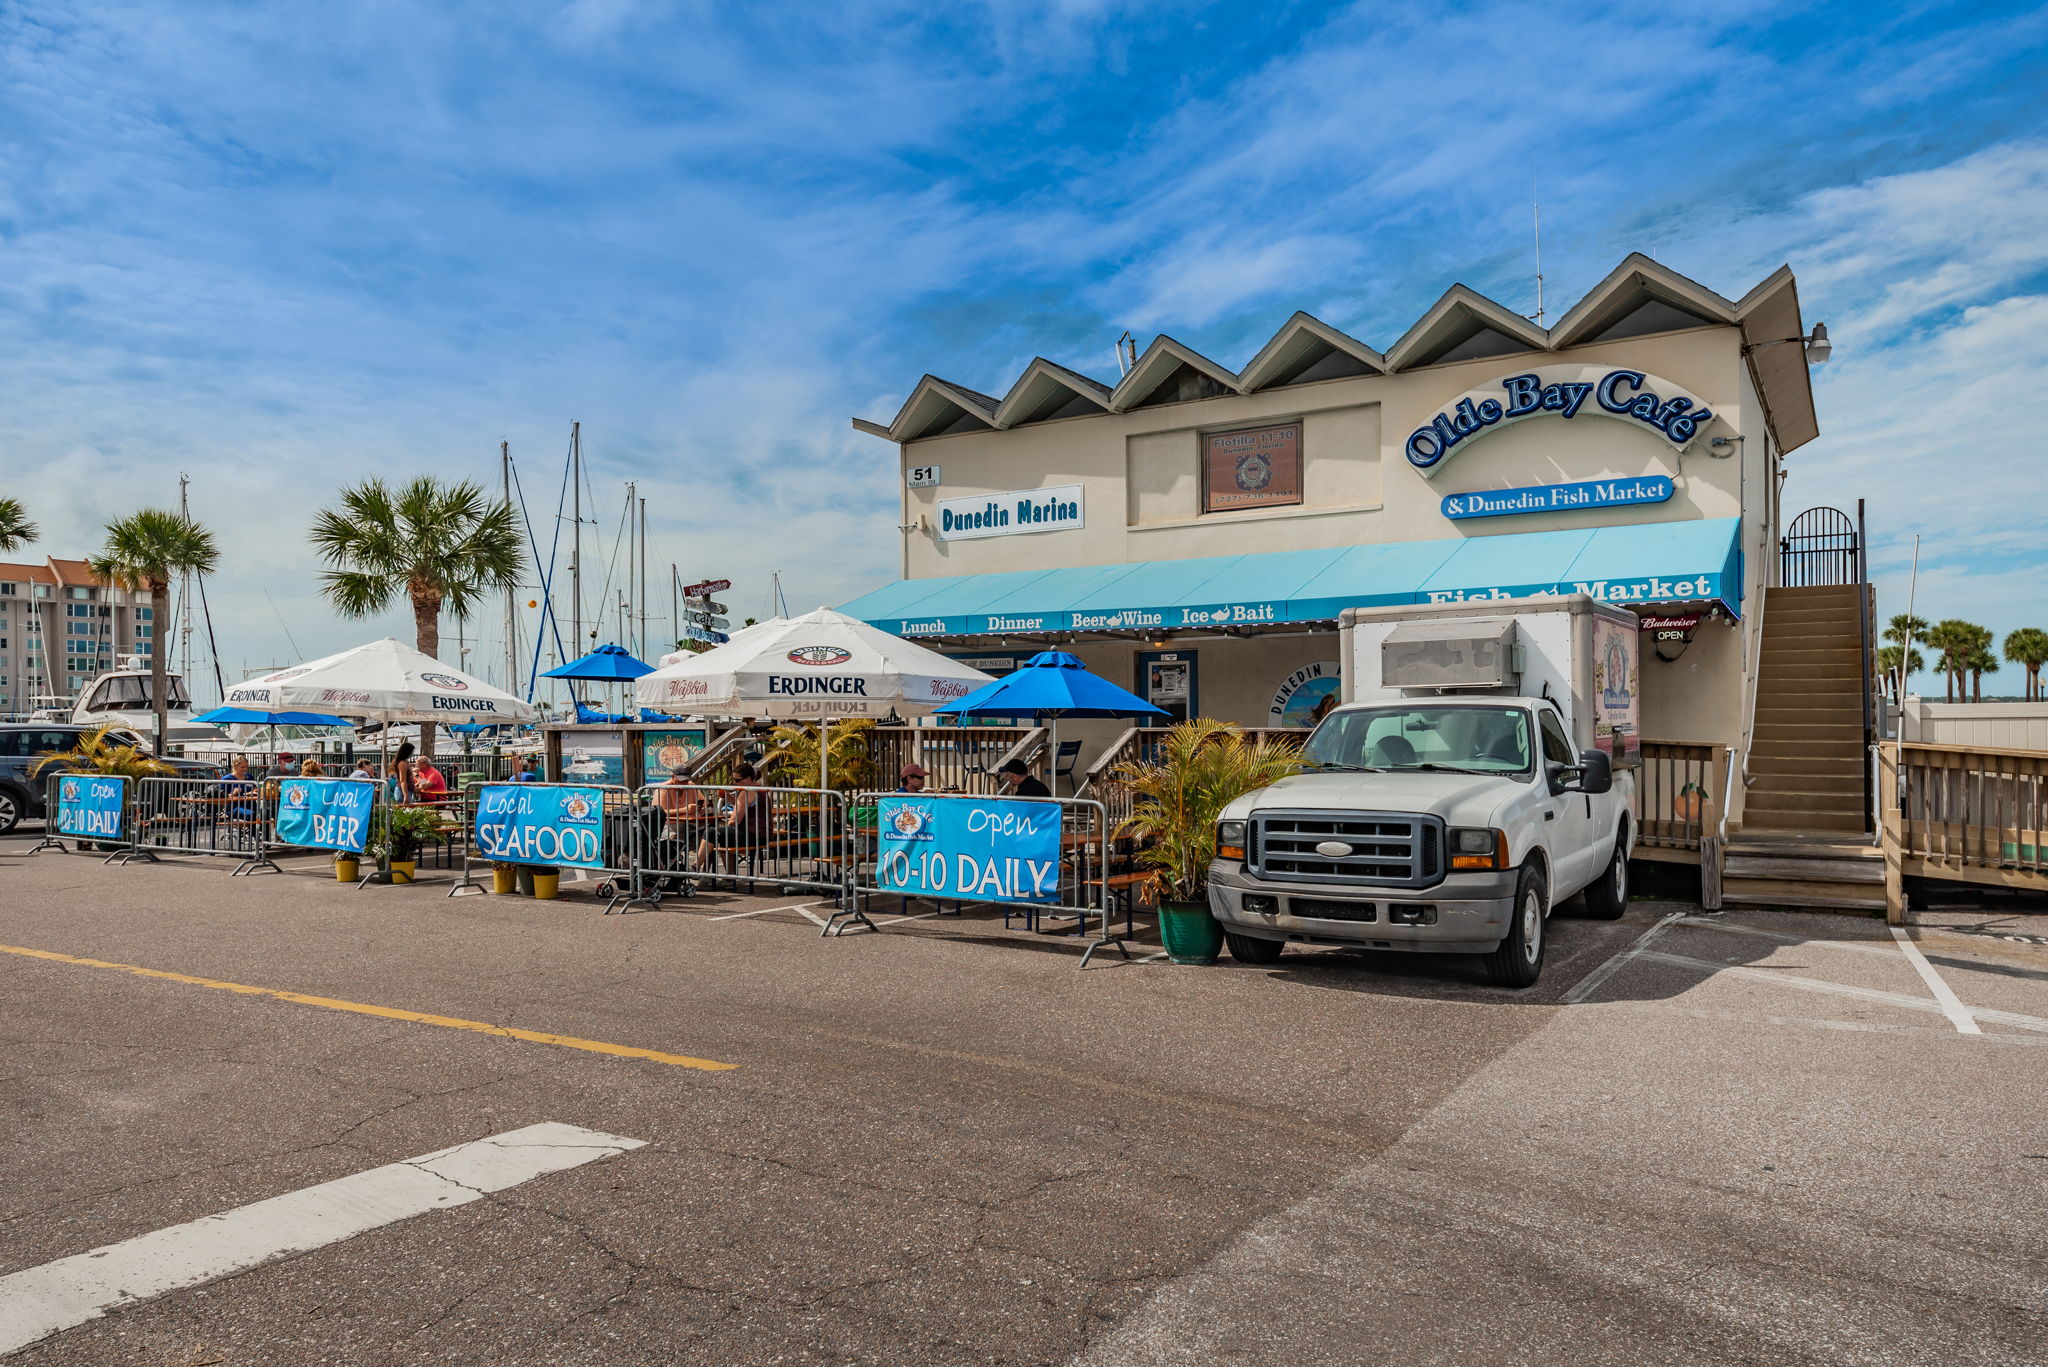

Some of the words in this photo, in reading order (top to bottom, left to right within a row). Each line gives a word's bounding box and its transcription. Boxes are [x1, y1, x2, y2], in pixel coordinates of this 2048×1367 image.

[1405, 397, 1503, 468] Olde
[1503, 373, 1594, 418] Bay
[1596, 370, 1713, 443] Café
[1214, 436, 1255, 448] Flotilla
[1260, 430, 1293, 442] 11-10
[1257, 442, 1284, 450] Florida
[914, 467, 932, 480] 51
[1215, 495, 1242, 504] (727)
[1448, 498, 1464, 515] &
[1468, 493, 1545, 513] Dunedin
[1551, 487, 1589, 506] Fish
[1595, 482, 1664, 502] Market
[943, 502, 1009, 532] Dunedin
[1017, 496, 1078, 524] Marina
[690, 581, 728, 598] Harbormaster
[1427, 588, 1511, 604] Fish
[1573, 576, 1711, 600] Market
[1071, 613, 1107, 627] Beer
[1122, 610, 1162, 626] Wine
[1182, 608, 1209, 623] Ice
[1232, 604, 1274, 621] Bait
[901, 619, 946, 634] Lunch
[988, 616, 1043, 631] Dinner
[1640, 618, 1697, 629] Budweiser
[1657, 631, 1684, 640] OPEN
[980, 659, 1012, 667] DUNEDIN
[768, 675, 868, 697] ERDINGER
[1271, 663, 1322, 715] DUNEDIN
[230, 689, 271, 703] ERDINGER
[431, 695, 498, 712] ERDINGER
[647, 737, 665, 756] Olde
[91, 783, 116, 805] Open
[322, 788, 359, 808] Local
[487, 792, 534, 815] Local
[87, 809, 120, 834] DAILY
[884, 807, 901, 822] Olde
[901, 803, 917, 815] Bay
[313, 814, 359, 848] BEER
[967, 809, 1038, 847] Open
[480, 823, 598, 862] SEAFOOD
[882, 849, 947, 891] 10-10
[956, 853, 1055, 898] DAILY
